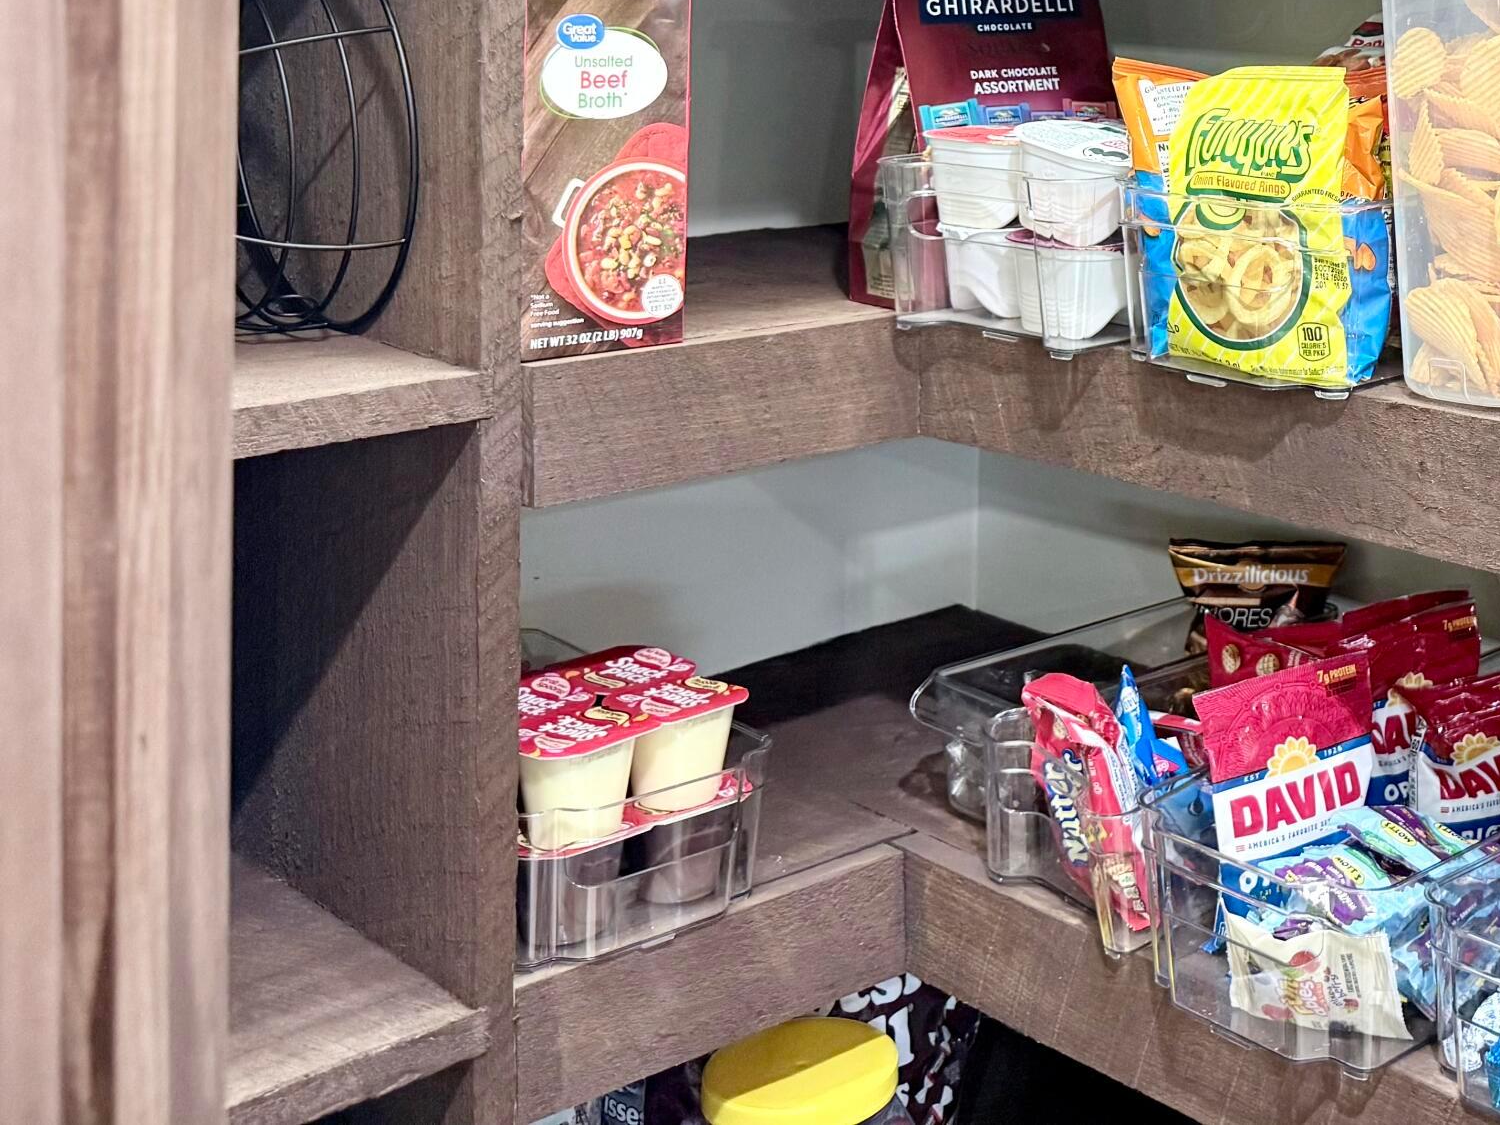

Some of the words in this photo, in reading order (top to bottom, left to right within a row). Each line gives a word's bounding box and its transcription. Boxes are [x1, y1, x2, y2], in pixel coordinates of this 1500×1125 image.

[563, 23, 597, 35] Great
[977, 22, 1033, 32] CHOCOLATE
[570, 33, 597, 43] Value
[574, 55, 633, 68] Unsalted
[580, 70, 628, 89] Beef
[970, 69, 998, 80] DARK
[1001, 66, 1058, 77] CHOCOLATE
[974, 78, 1060, 95] ASSORTMENT
[1193, 176, 1213, 186] Onion
[1217, 175, 1256, 191] Flavored
[1258, 181, 1286, 195] Rings
[1292, 189, 1325, 203] GUARANTEED
[530, 337, 549, 350] NET
[550, 335, 565, 348] WT
[566, 334, 578, 346] 32
[579, 332, 592, 344] OZ
[604, 329, 620, 341] LB)
[620, 327, 643, 340] 907g
[1302, 326, 1323, 341] 100
[1301, 342, 1327, 350] CALORIES
[1193, 567, 1309, 585] Drizzilicious
[1216, 606, 1273, 629] ORES
[1453, 615, 1477, 629] PROTEIN
[605, 657, 670, 678] Snack
[1317, 670, 1329, 685] 7g
[1329, 664, 1357, 679] PROTEIN
[644, 687, 711, 708] Snack
[1323, 745, 1343, 758] 1926
[1243, 772, 1261, 783] EST
[1229, 760, 1362, 839] DAVID
[1451, 801, 1484, 814] AMERICA'S
[1248, 834, 1286, 851] AMERICA'S
[1287, 825, 1319, 842] FAVORITE
